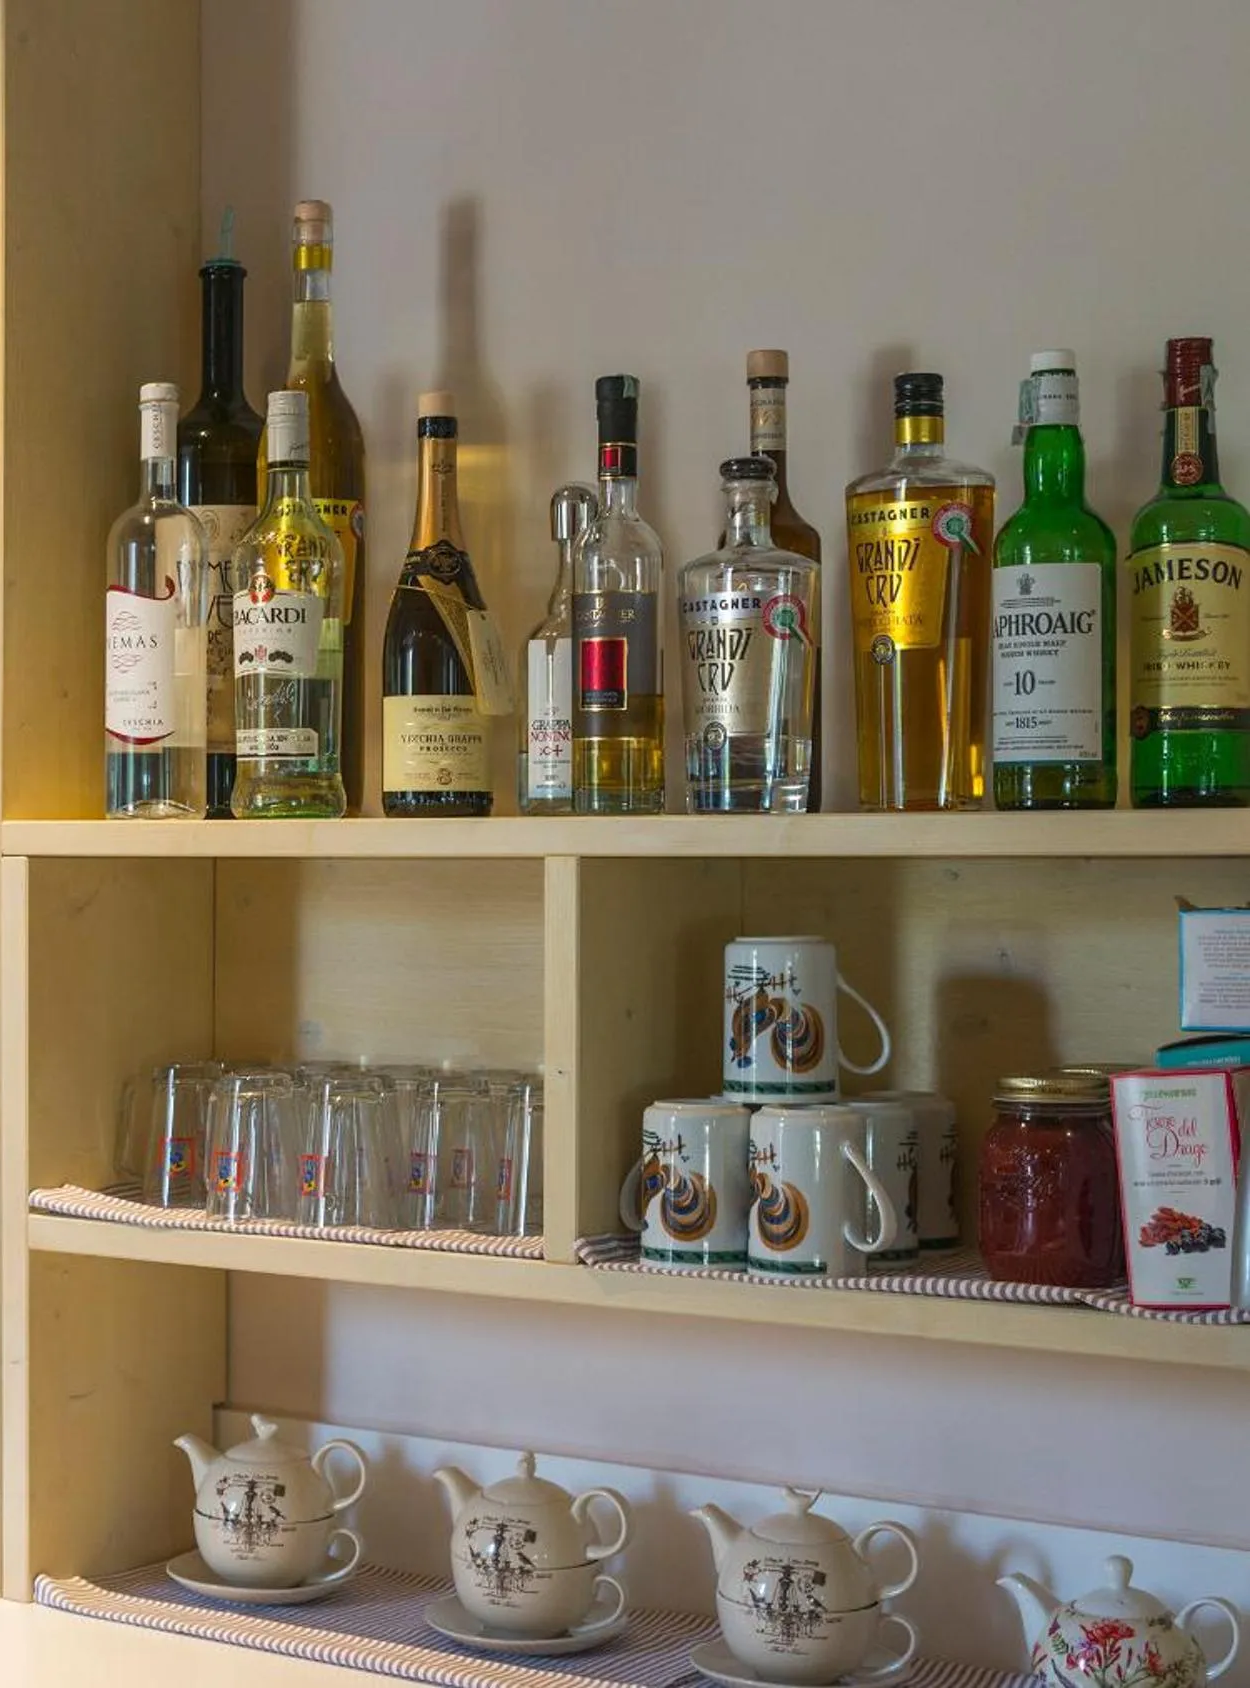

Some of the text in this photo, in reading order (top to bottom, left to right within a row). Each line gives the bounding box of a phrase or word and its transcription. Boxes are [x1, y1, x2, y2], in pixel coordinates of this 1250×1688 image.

[850, 507, 930, 525] CASTAGNER
[1133, 558, 1243, 595] JAMESON
[683, 597, 762, 614] CASTAGNER
[993, 611, 1093, 639] APHROAIG
[108, 635, 159, 650] EMAS
[1014, 669, 1036, 696] 10
[1014, 716, 1039, 729] 1815
